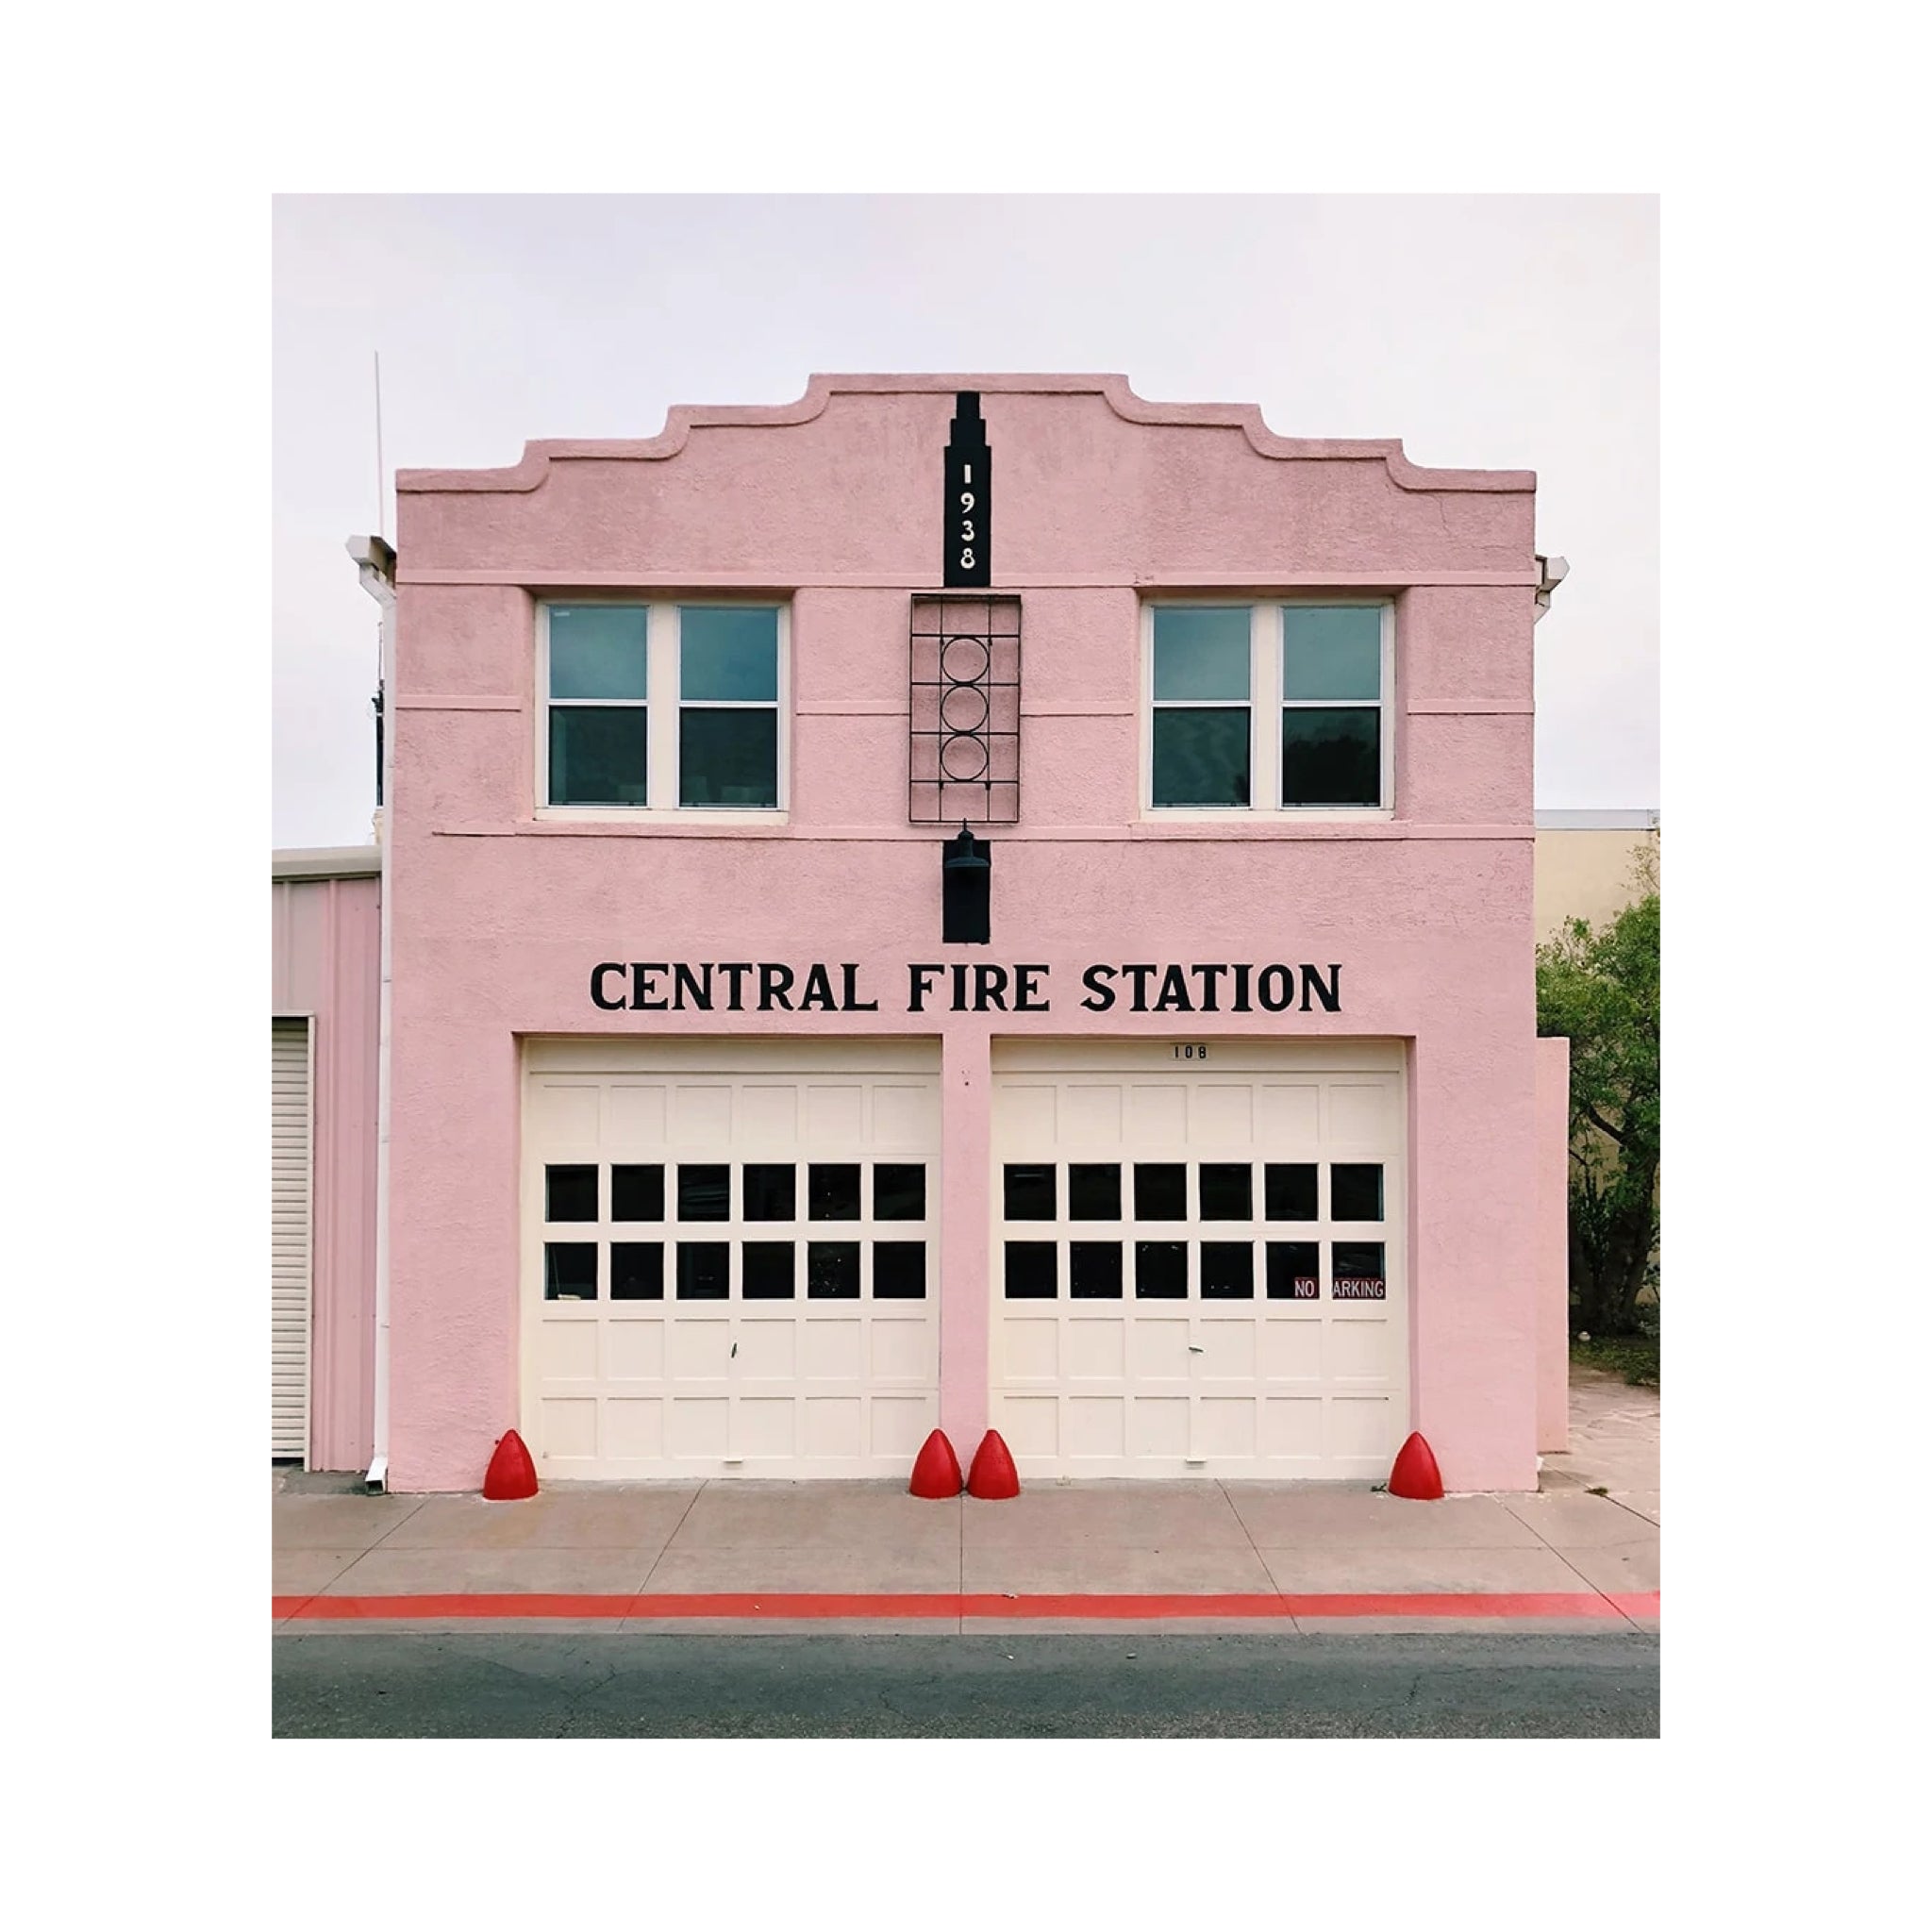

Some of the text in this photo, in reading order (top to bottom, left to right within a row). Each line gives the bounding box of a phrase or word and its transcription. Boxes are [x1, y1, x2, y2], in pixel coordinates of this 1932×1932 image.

[960, 464, 975, 570] 1938
[591, 963, 1341, 1012] CENTRAL FIRE STATION
[1174, 1044, 1207, 1058] 108
[1294, 1280, 1384, 1298] NO ARKING
